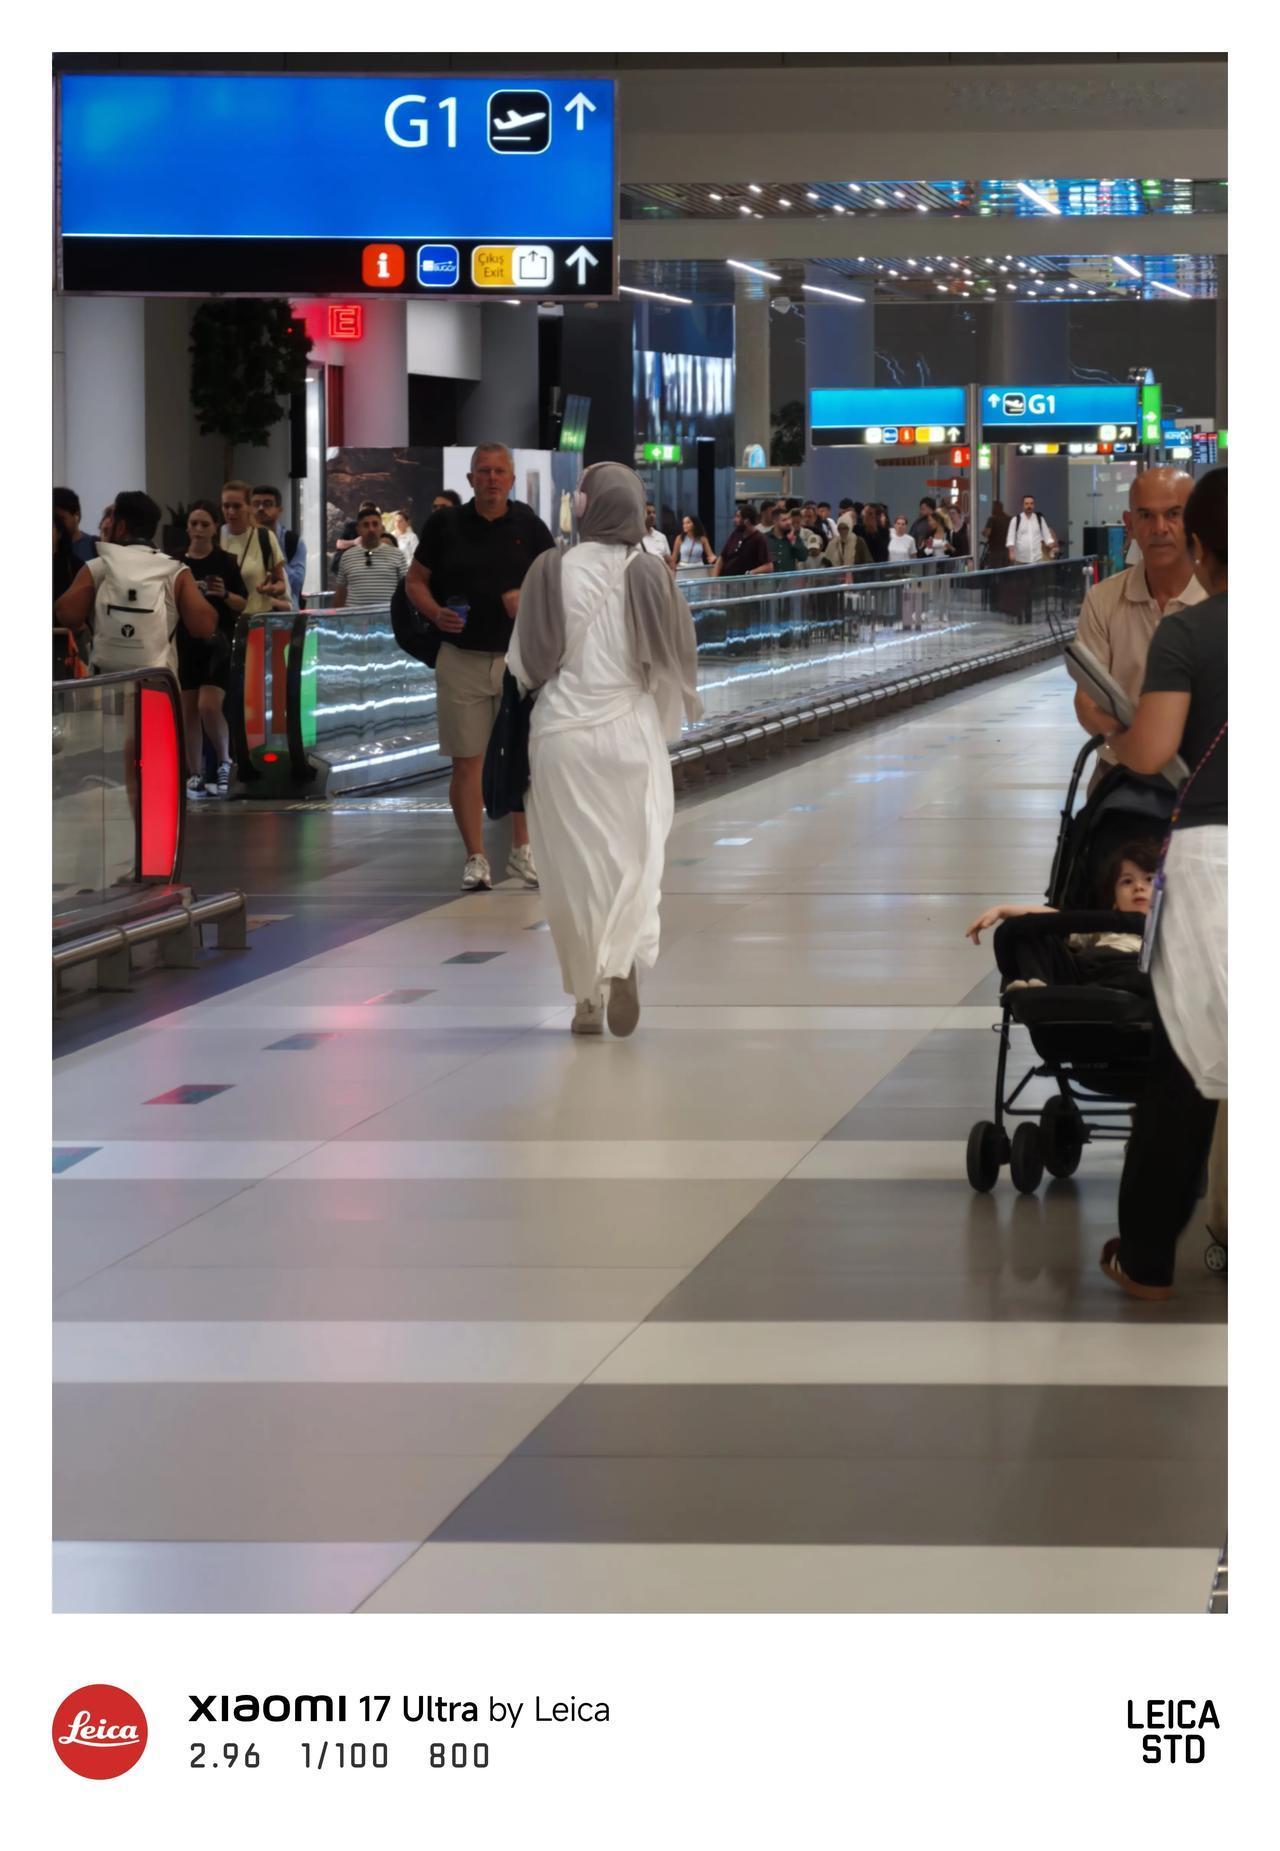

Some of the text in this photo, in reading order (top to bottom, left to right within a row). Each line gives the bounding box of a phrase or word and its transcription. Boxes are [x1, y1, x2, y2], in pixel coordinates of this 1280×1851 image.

[384, 94, 457, 148] G1
[478, 253, 504, 266] Çıkış
[484, 267, 504, 279] Exit
[1028, 394, 1056, 415] G1
